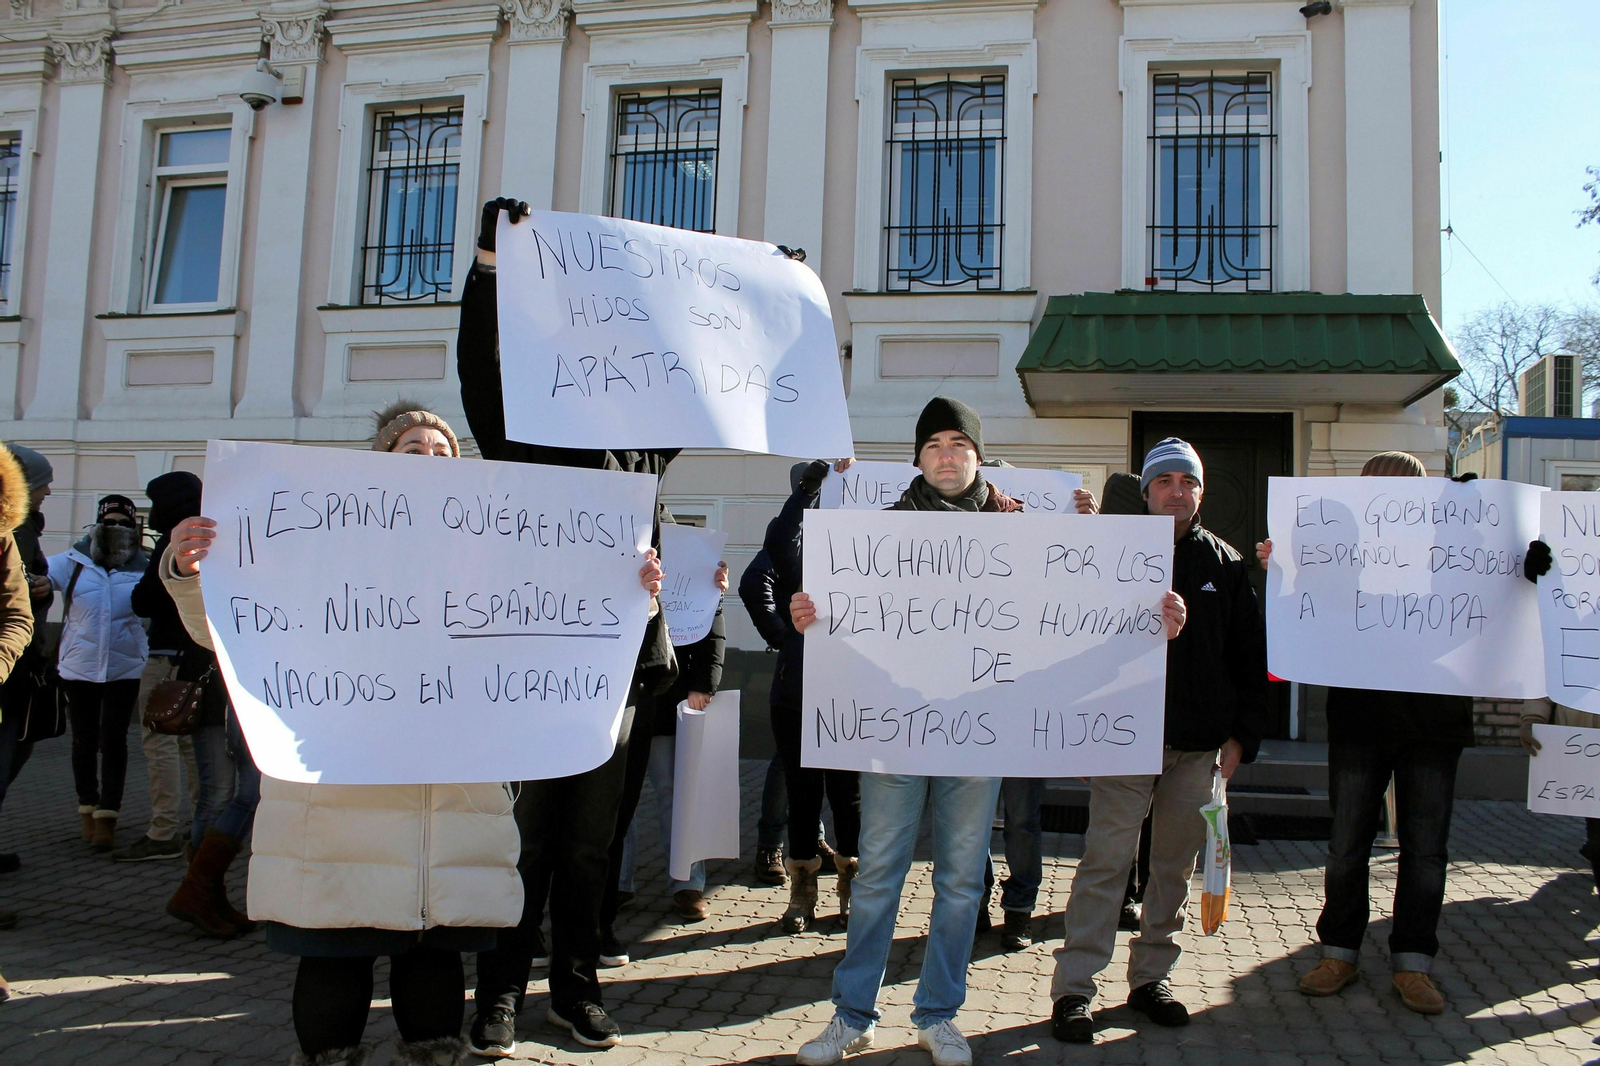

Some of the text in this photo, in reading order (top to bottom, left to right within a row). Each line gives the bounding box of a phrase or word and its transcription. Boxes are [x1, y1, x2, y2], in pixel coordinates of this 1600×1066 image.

[531, 227, 742, 292] NUESTROS
[688, 304, 742, 331] SON
[552, 345, 800, 403] APÁTRIDAS
[1296, 492, 1500, 539] EL GOBIERNO
[827, 529, 1165, 583] LUCHAMOS POR LOS
[1300, 541, 1411, 569] ESPAÑOL
[443, 581, 620, 629] ESPAÑOLES
[828, 591, 1164, 640] DERECHOS HUMANOS
[1299, 588, 1488, 637] A EUROPA
[419, 665, 454, 705] EN
[971, 645, 1015, 684] DE
[816, 698, 1137, 751] NUESTROS HIJOS
[1537, 780, 1600, 801] ESPA
